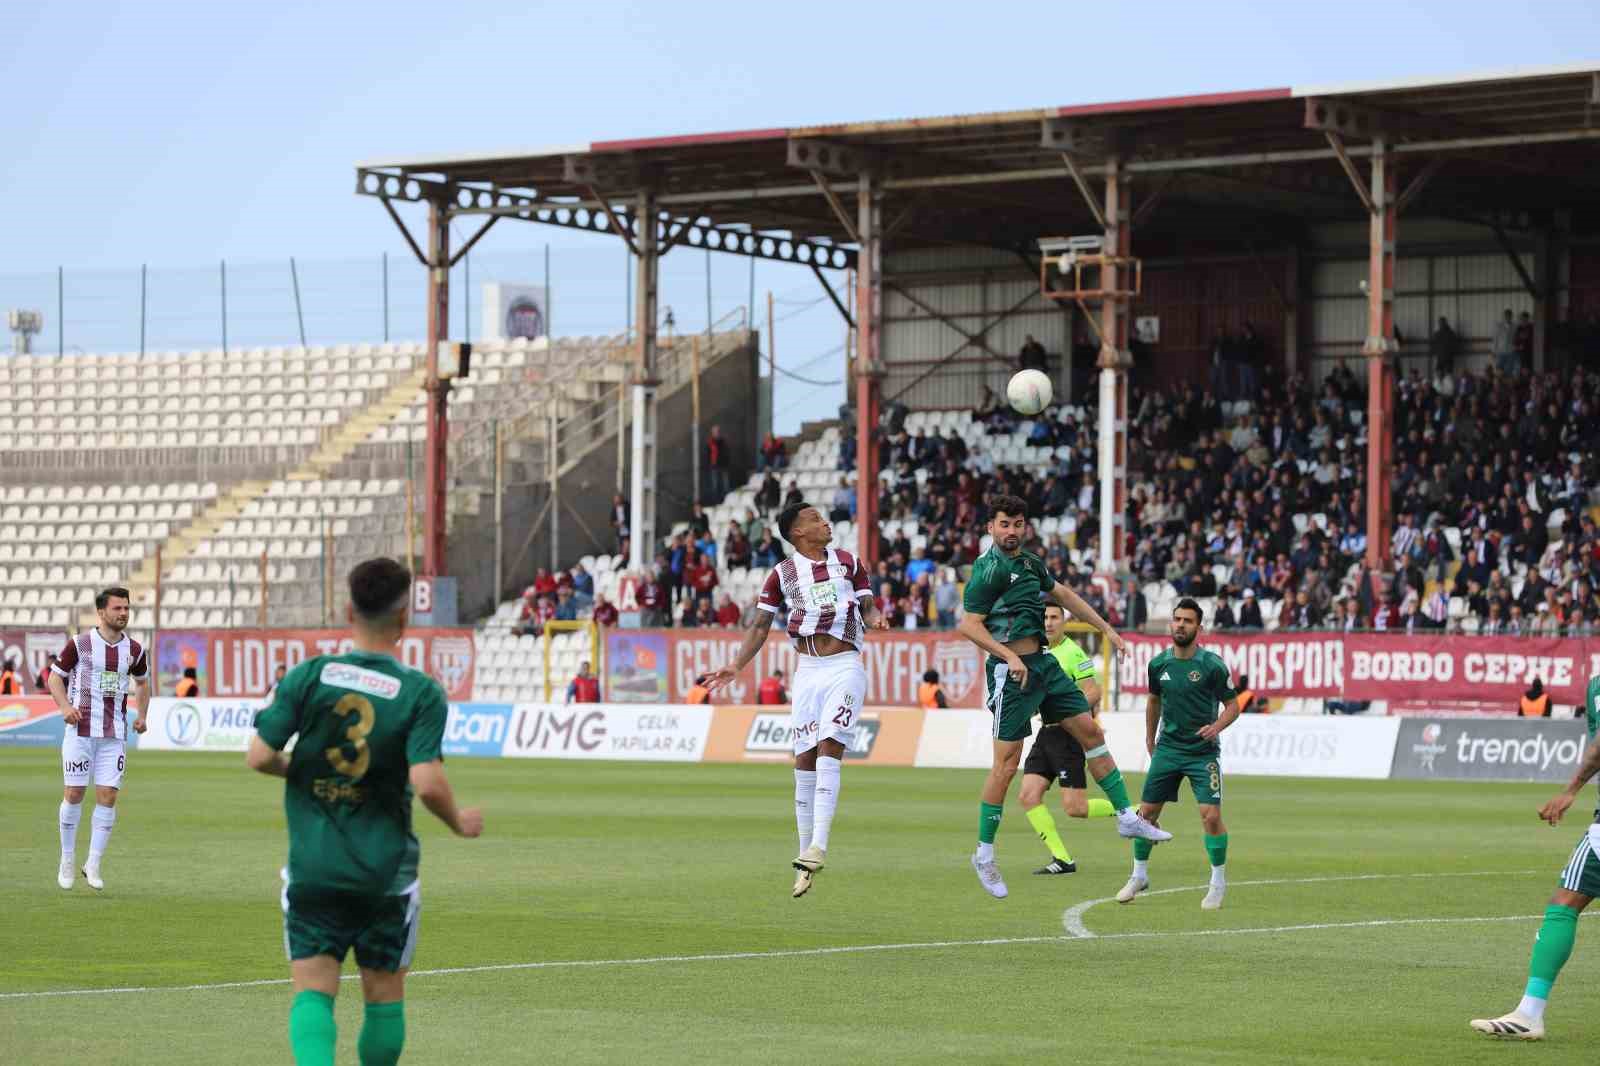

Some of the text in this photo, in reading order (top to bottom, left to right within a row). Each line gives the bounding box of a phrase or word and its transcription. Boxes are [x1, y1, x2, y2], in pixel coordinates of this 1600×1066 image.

[415, 580, 431, 611] B
[1351, 651, 1454, 682] BORDO
[1464, 652, 1573, 686] CEPHE
[514, 709, 606, 751] UMG
[832, 706, 852, 728] 23
[326, 693, 375, 782] 3
[611, 736, 672, 752] YAPILAR
[1456, 730, 1586, 770] trendyol
[65, 760, 90, 772] UMG
[117, 755, 125, 772] 6
[1210, 773, 1221, 791] 8
